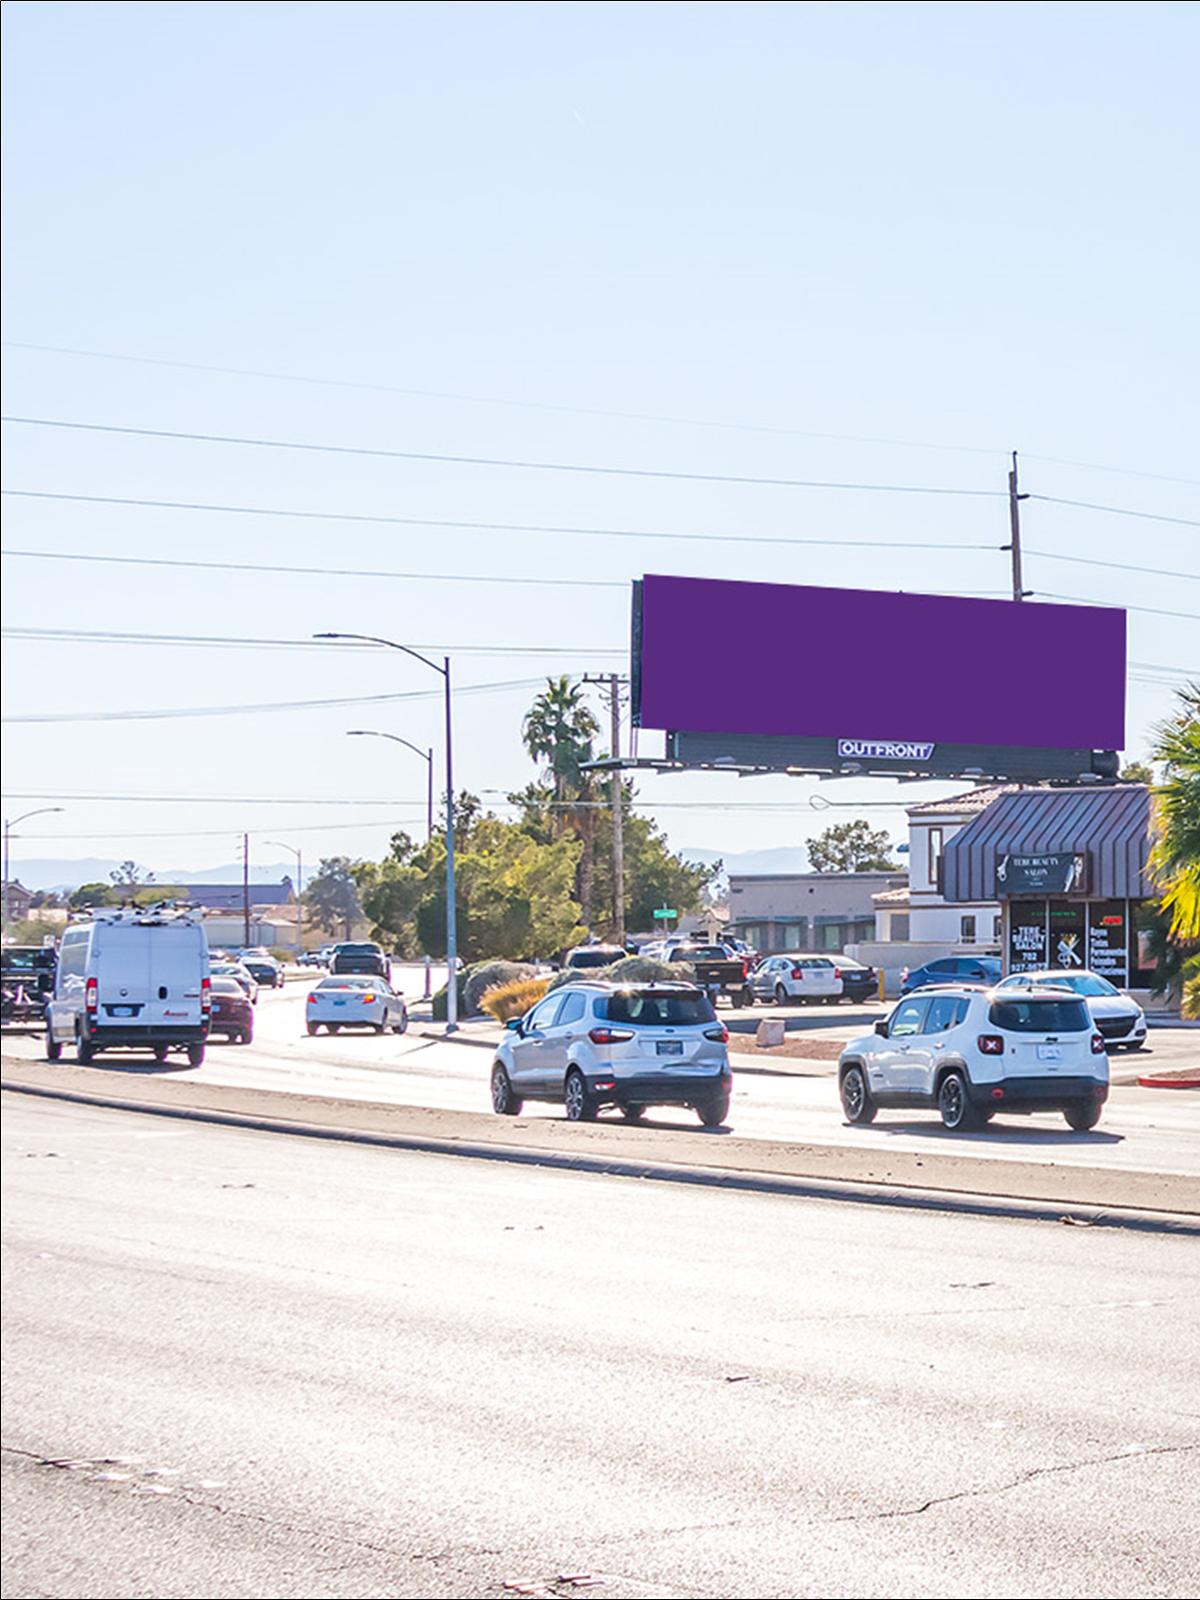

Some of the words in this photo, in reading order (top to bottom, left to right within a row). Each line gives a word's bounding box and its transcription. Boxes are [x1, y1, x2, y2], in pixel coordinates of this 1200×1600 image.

[842, 742, 927, 758] OUTFRONT
[1015, 942, 1043, 950] SALON
[1022, 952, 1037, 961] 702
